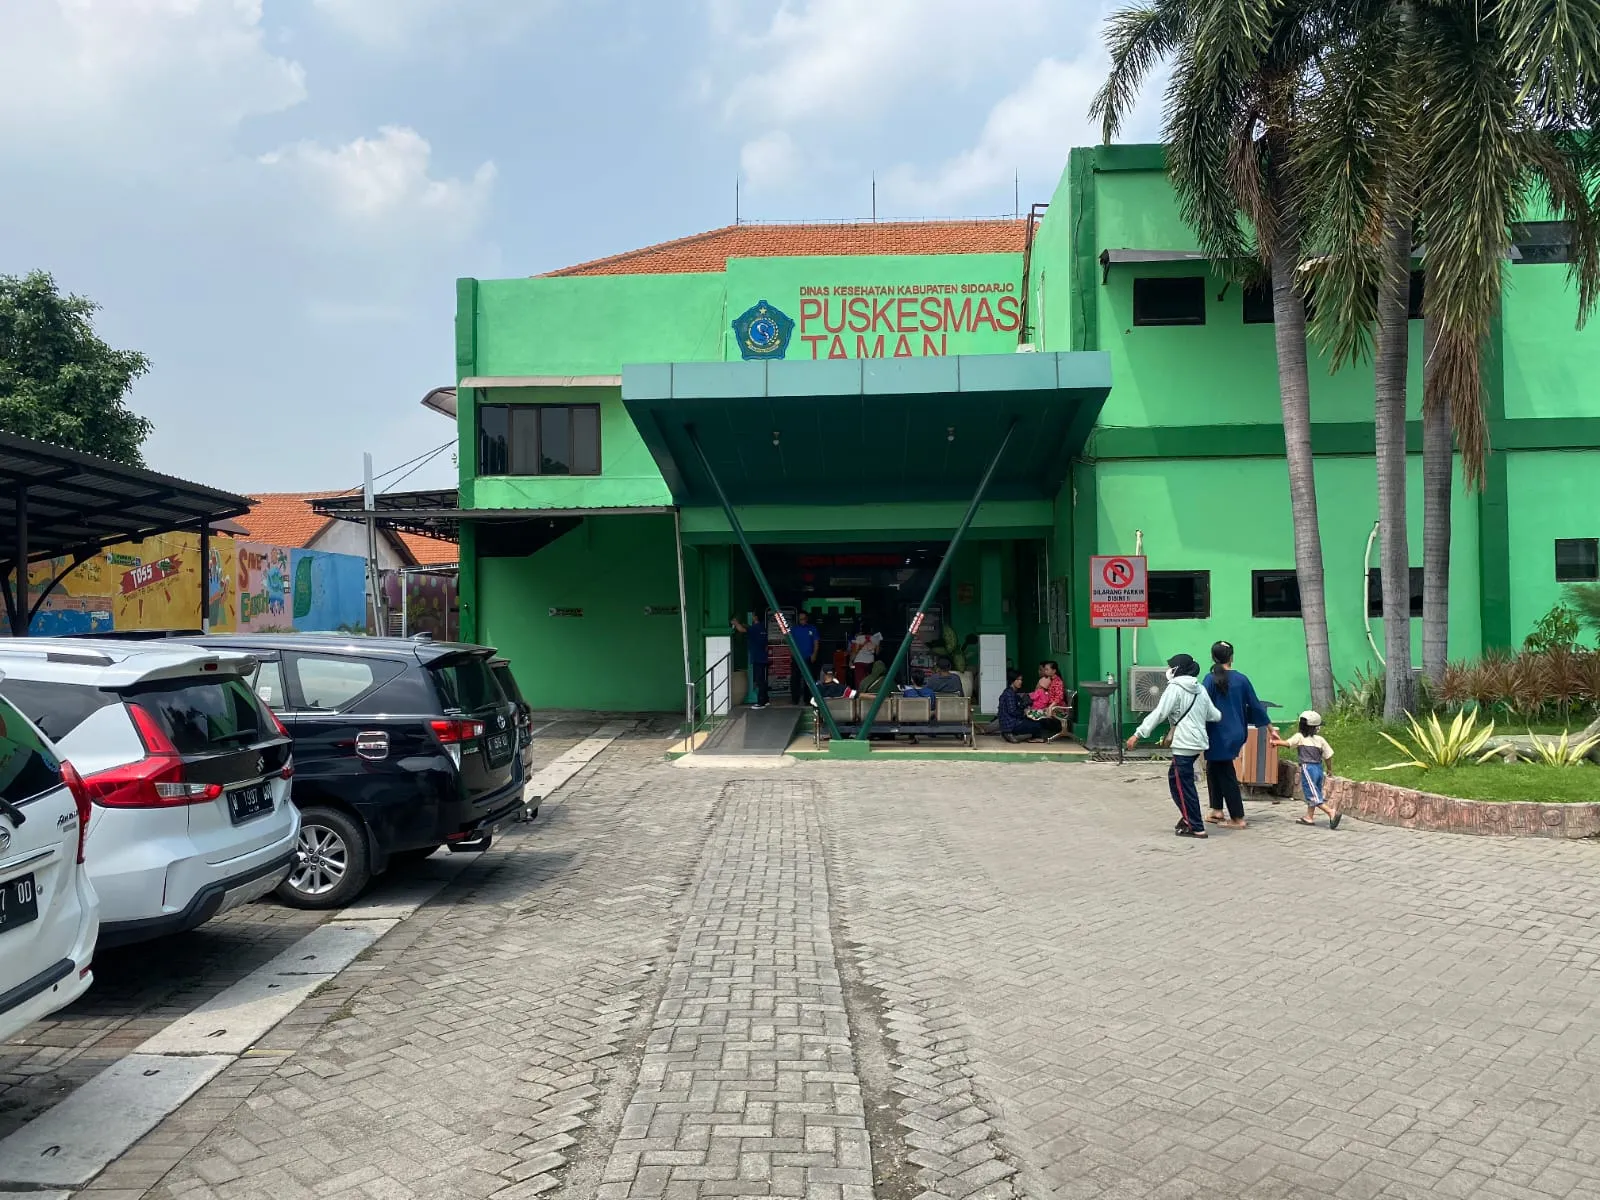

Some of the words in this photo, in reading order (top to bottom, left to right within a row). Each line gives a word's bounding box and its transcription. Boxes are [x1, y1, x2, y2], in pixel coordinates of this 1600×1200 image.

[800, 286, 829, 296] DINAS
[833, 285, 895, 296] KESEHATAN
[897, 284, 958, 295] KABUPATEN
[961, 283, 1014, 294] SIDOARJO
[800, 297, 1020, 333] PUSKESMAS
[801, 334, 947, 360] TAMAN
[131, 564, 153, 588] TOSS
[243, 788, 258, 806] 1997
